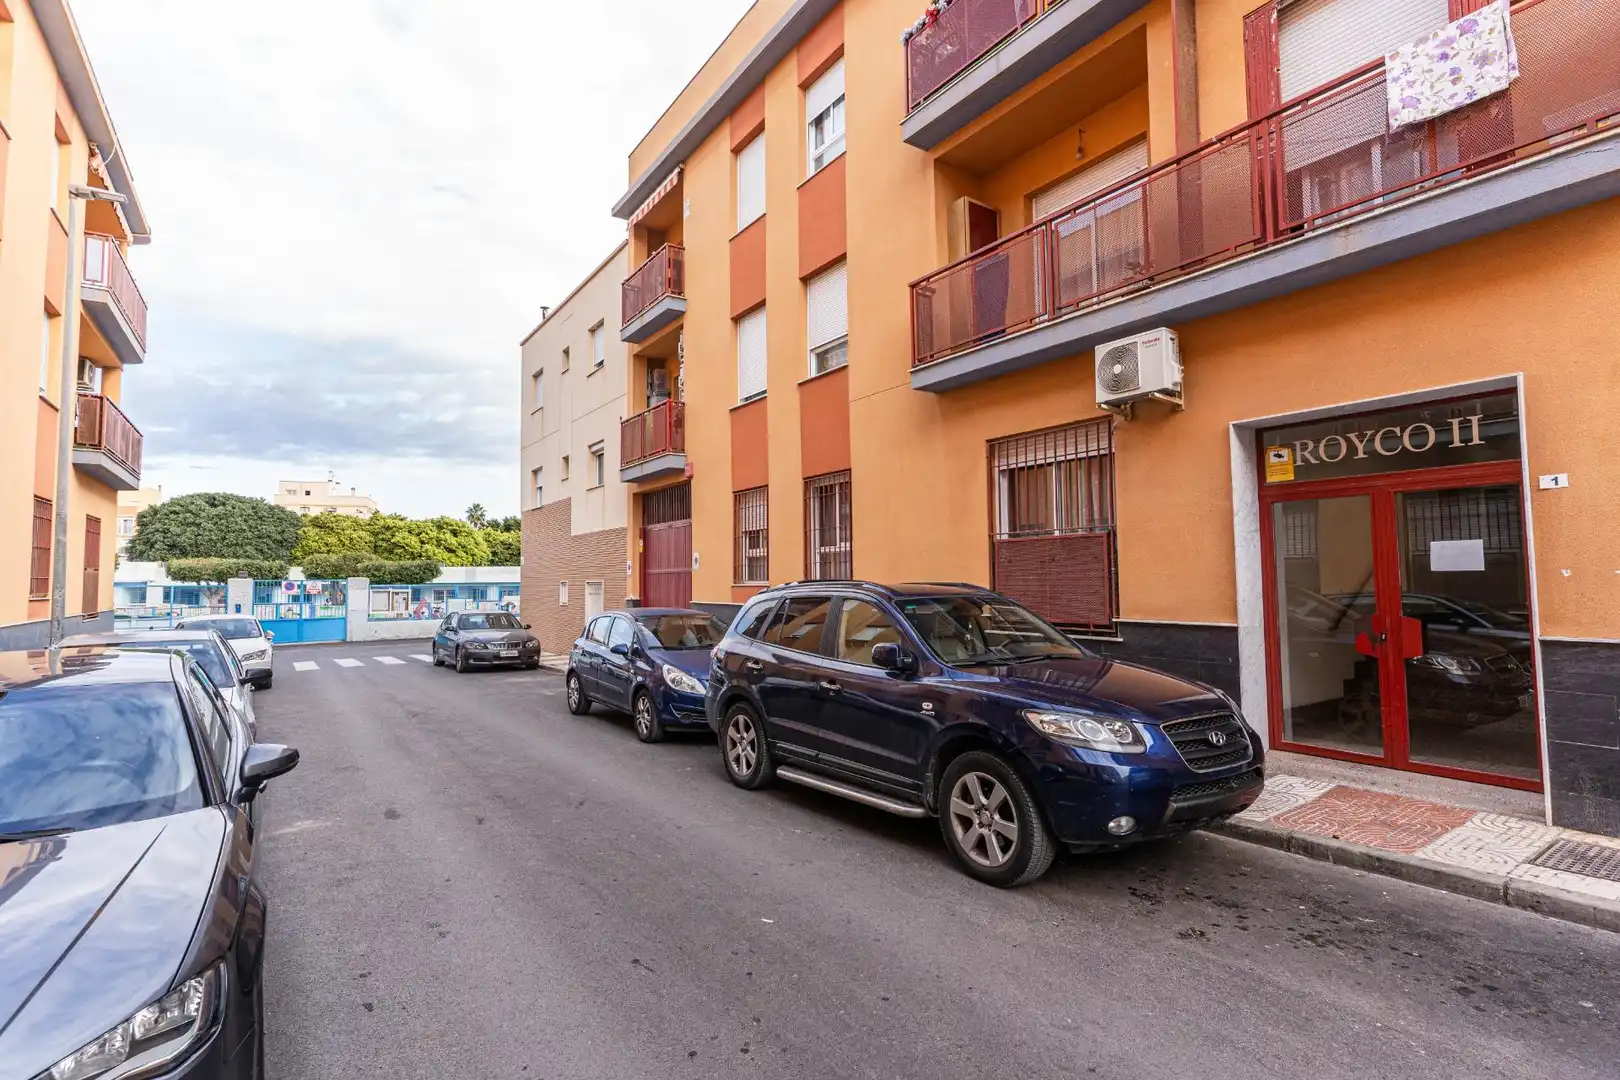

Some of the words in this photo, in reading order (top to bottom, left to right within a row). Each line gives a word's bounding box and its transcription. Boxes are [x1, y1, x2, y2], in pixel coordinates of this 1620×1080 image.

[1293, 423, 1436, 466] ROYCO
[1448, 415, 1485, 448] II
[1551, 476, 1559, 486] 1
